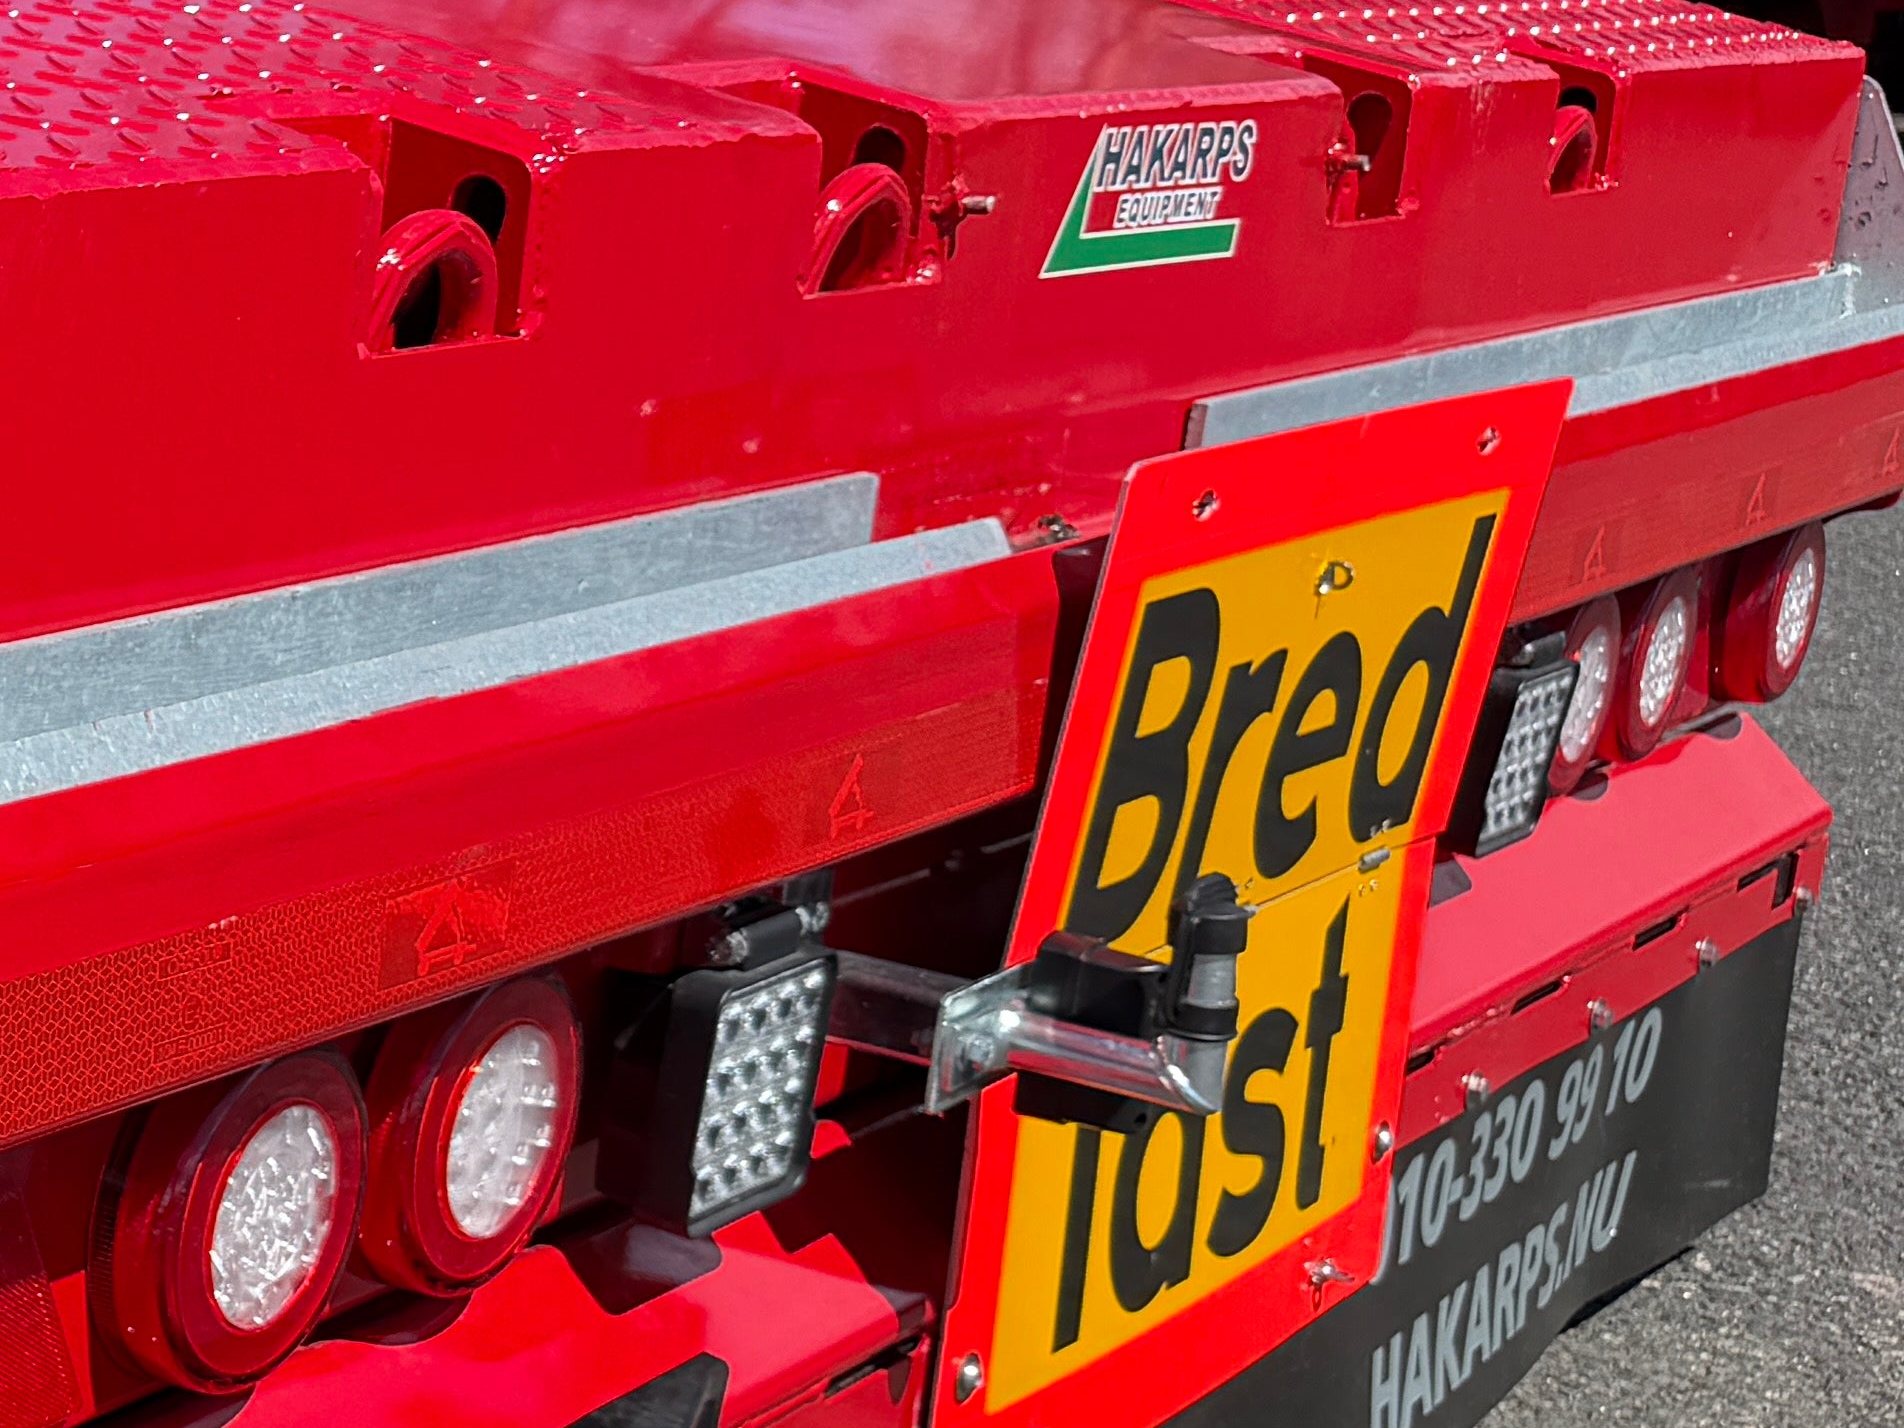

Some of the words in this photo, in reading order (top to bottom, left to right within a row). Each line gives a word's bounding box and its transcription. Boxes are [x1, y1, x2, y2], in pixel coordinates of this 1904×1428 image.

[1093, 120, 1257, 192] HAKARPS
[1113, 186, 1223, 229] EQUIPMENT
[1065, 513, 1497, 944] Bred
[1370, 1078, 1545, 1285] 10-330
[1548, 1044, 1604, 1160] 99
[1605, 1007, 1662, 1116] 10
